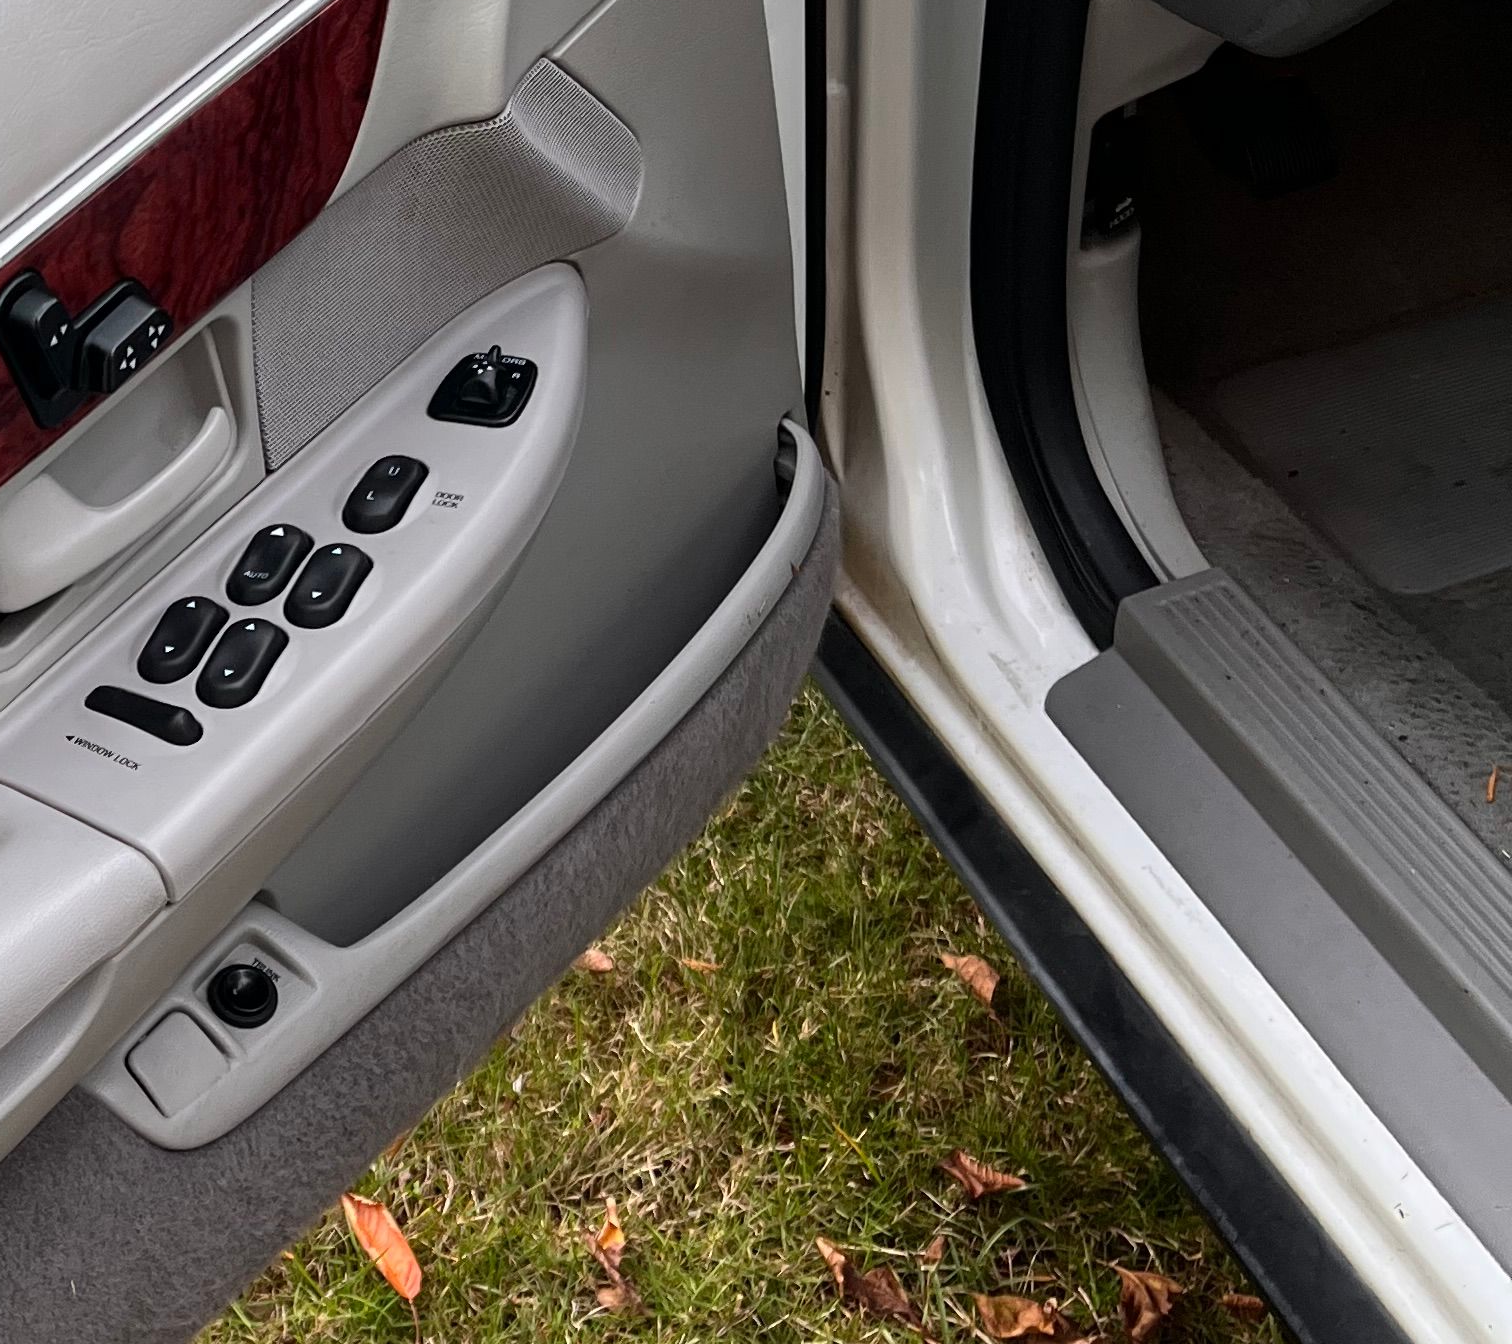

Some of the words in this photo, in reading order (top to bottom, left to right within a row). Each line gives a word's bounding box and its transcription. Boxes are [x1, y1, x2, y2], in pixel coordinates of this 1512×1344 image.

[388, 466, 400, 477] U
[366, 490, 375, 501] L
[435, 491, 465, 502] DOOR
[431, 498, 458, 509] LOCK
[243, 570, 269, 580] AUTO
[74, 737, 115, 758] WINDOW
[113, 754, 143, 771] LOCK
